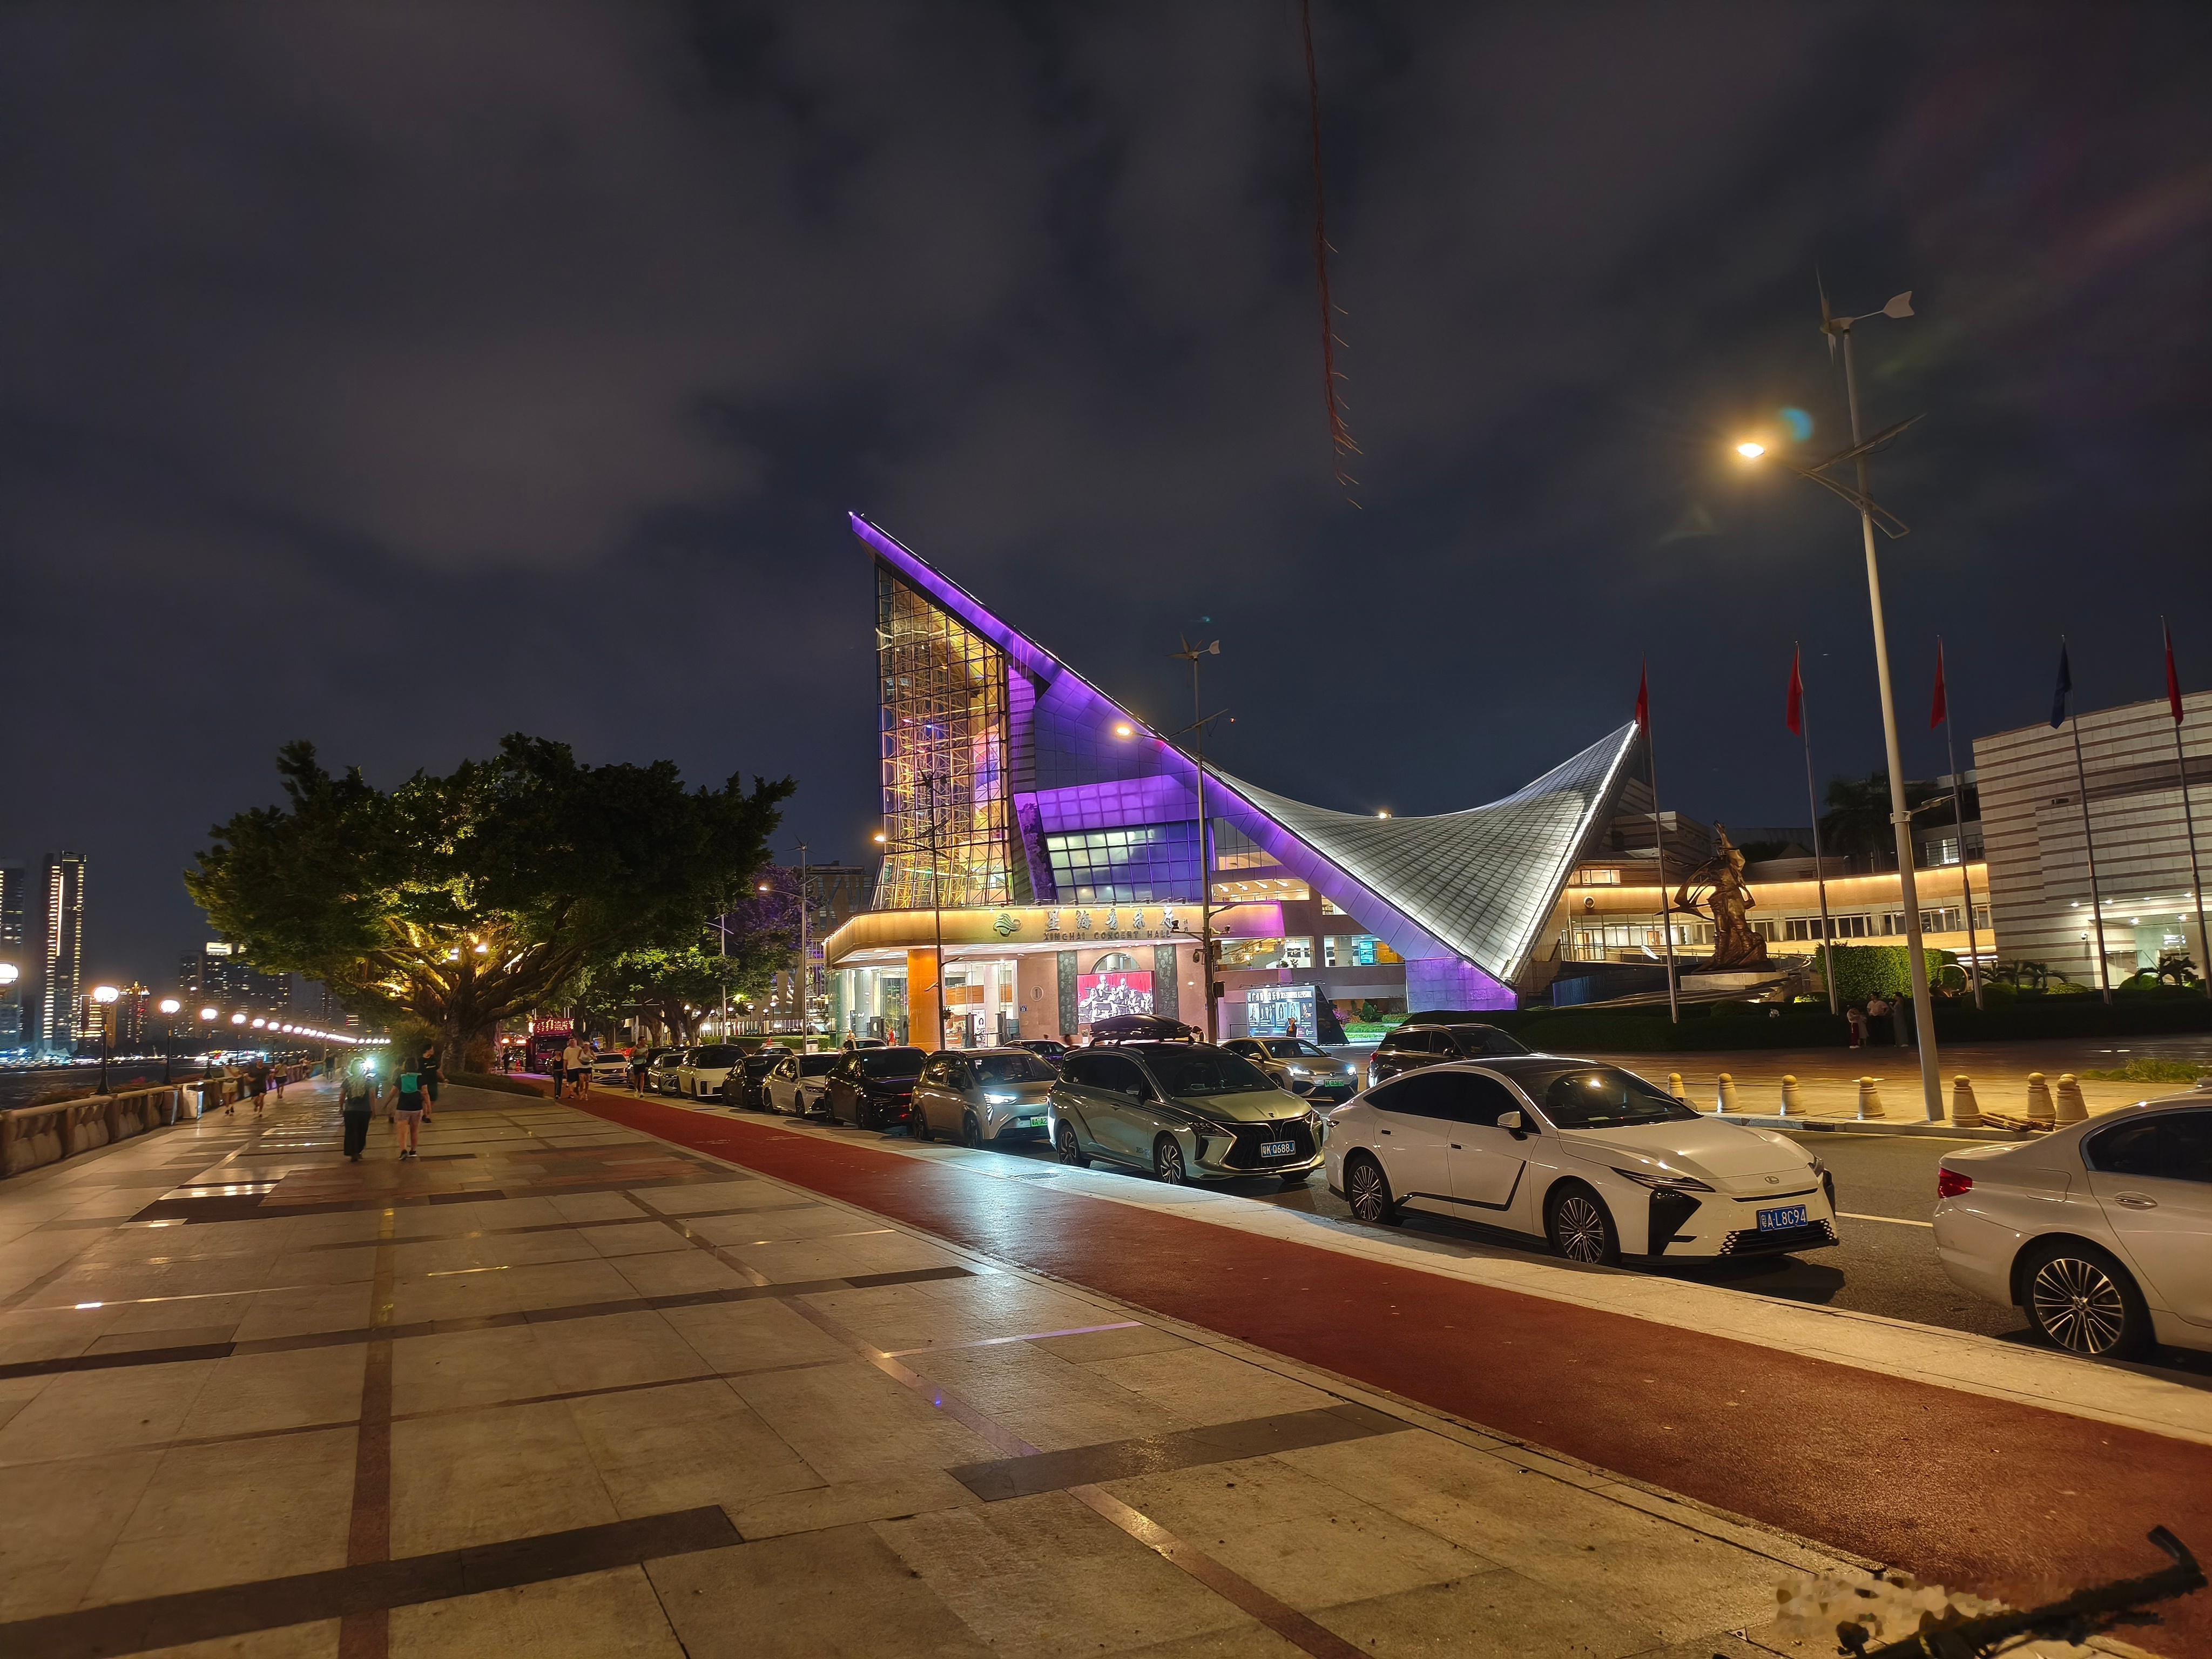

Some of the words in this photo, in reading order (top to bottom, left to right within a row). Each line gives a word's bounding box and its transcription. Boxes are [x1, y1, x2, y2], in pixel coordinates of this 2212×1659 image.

[1043, 932, 1085, 941] XINGHAI
[1094, 931, 1138, 940] CONCERT
[1147, 930, 1171, 939] HALL
